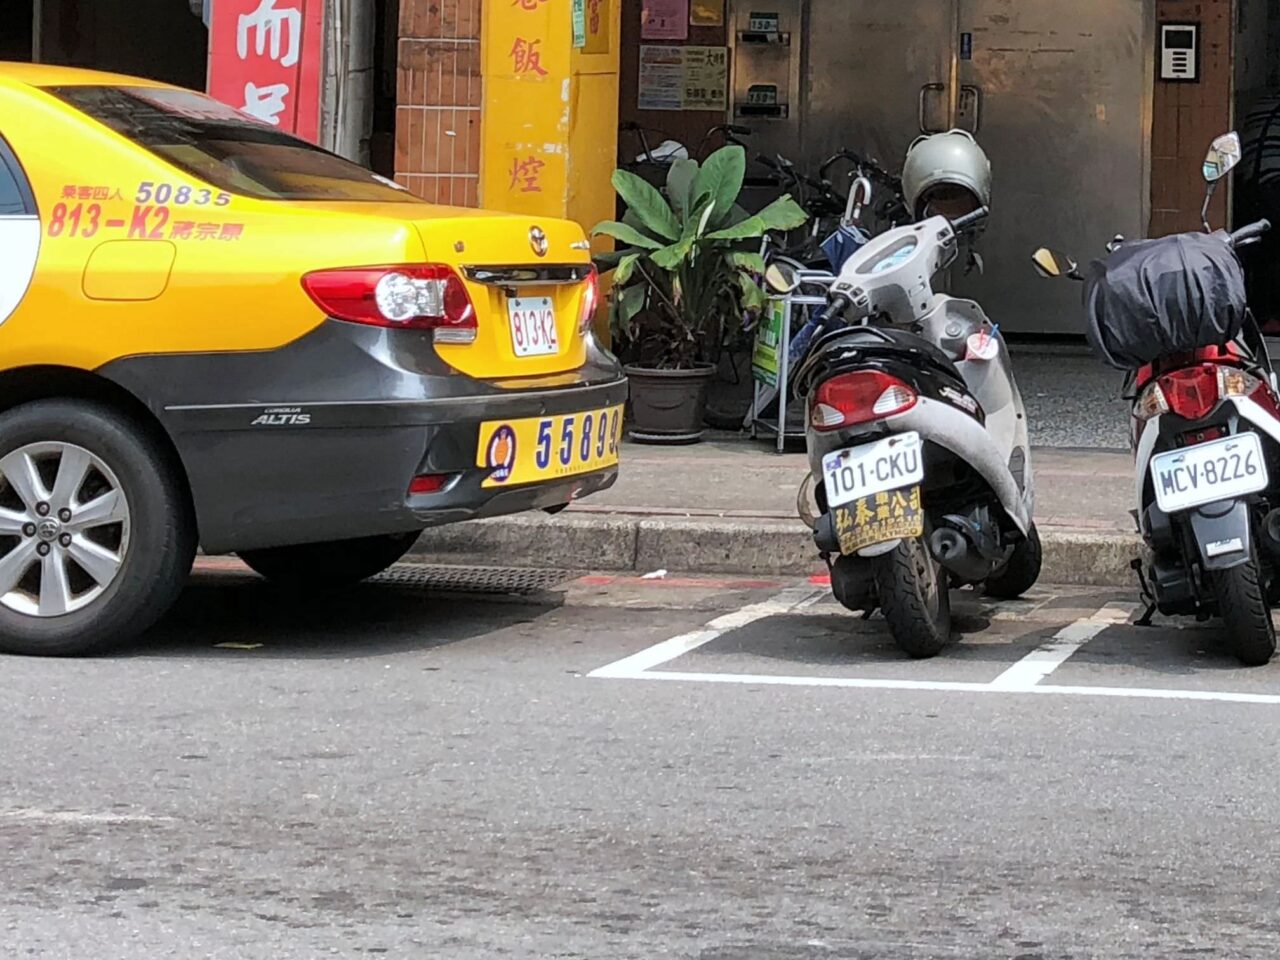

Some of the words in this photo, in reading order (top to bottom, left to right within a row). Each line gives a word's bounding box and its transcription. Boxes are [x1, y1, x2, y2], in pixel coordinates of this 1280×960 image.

[61, 185, 124, 201] 乘客四人
[135, 181, 232, 207] 50835
[47, 202, 170, 240] 813-K2
[251, 414, 311, 425] ALTIS
[536, 408, 619, 470] 55899
